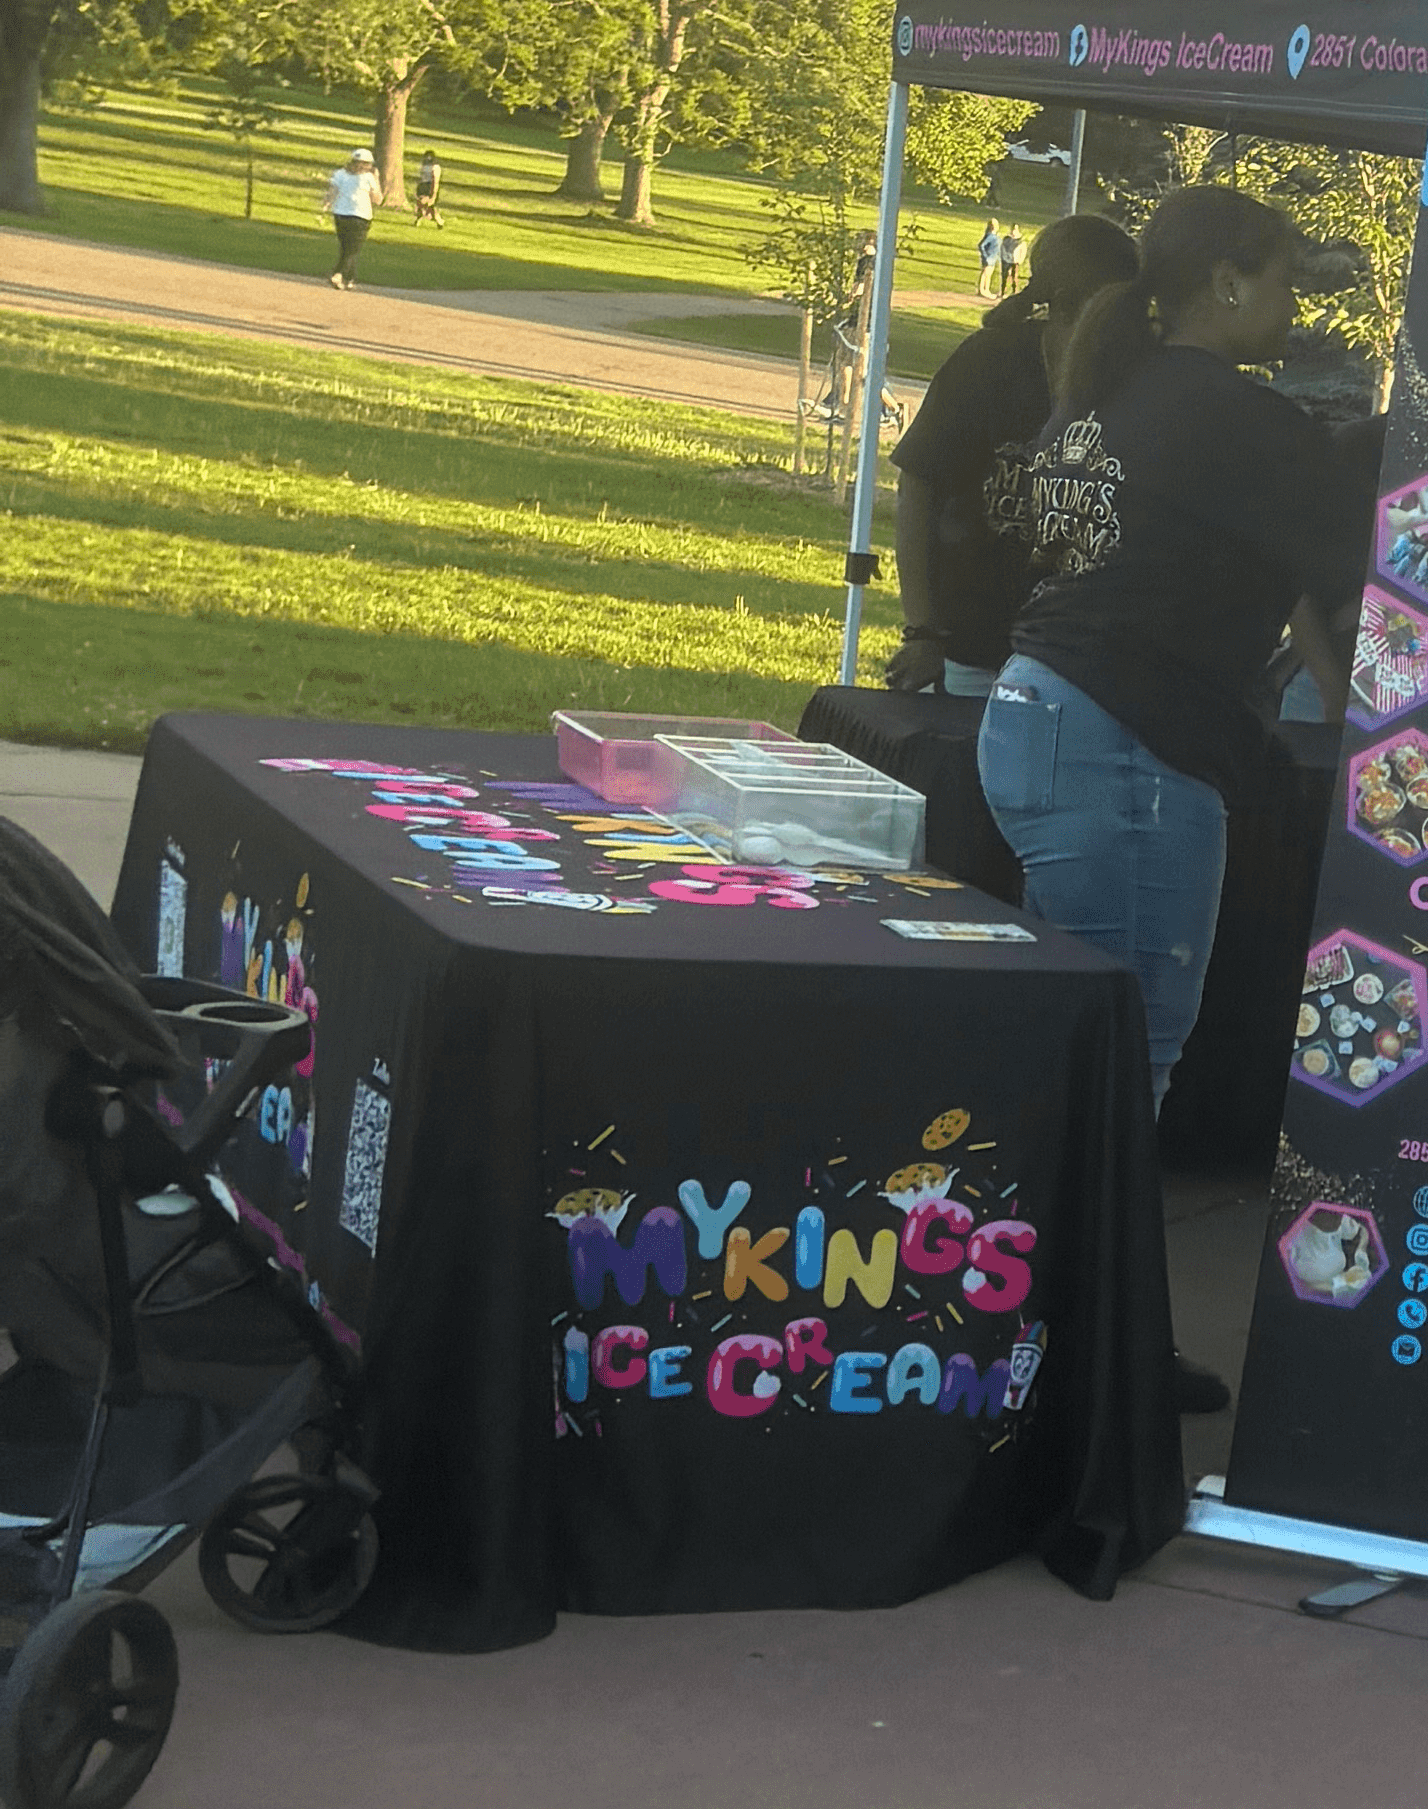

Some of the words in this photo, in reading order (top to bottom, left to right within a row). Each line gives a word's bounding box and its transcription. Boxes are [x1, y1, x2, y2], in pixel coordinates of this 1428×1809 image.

[914, 15, 1061, 62] mykingsicecream
[1088, 26, 1172, 76] MyKings
[1176, 32, 1274, 74] IceCream
[1311, 34, 1356, 68] 2851
[566, 1179, 1038, 1312] MYKINGS
[563, 1324, 693, 1404] ICE
[706, 1316, 1013, 1419] CREAM
